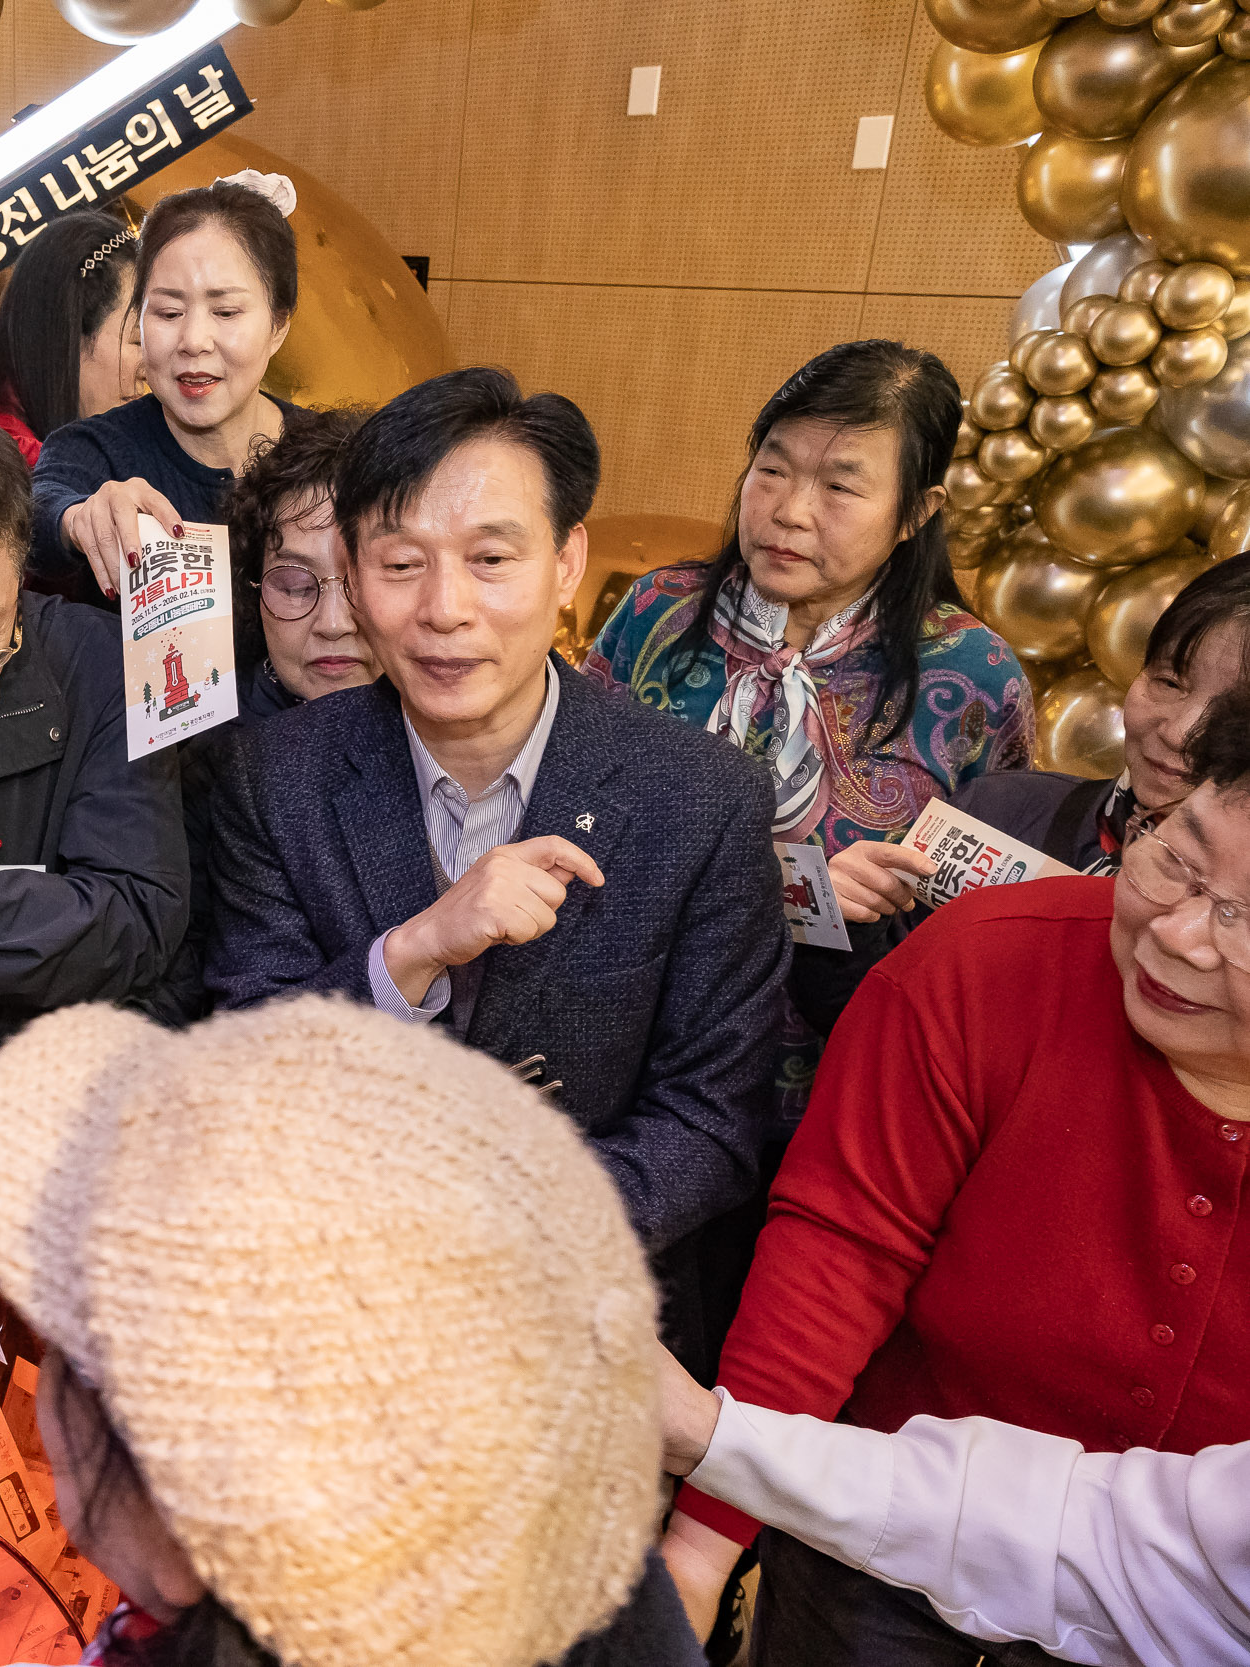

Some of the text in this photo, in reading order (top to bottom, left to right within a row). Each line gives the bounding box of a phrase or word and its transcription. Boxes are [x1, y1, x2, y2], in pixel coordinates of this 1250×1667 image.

[40, 98, 183, 211] 나눔의
[173, 64, 236, 130] 날
[156, 541, 213, 553] 희망온돌
[129, 552, 214, 594] 따뜻한
[131, 572, 213, 614] 겨울나기
[930, 826, 963, 863] 망온돌
